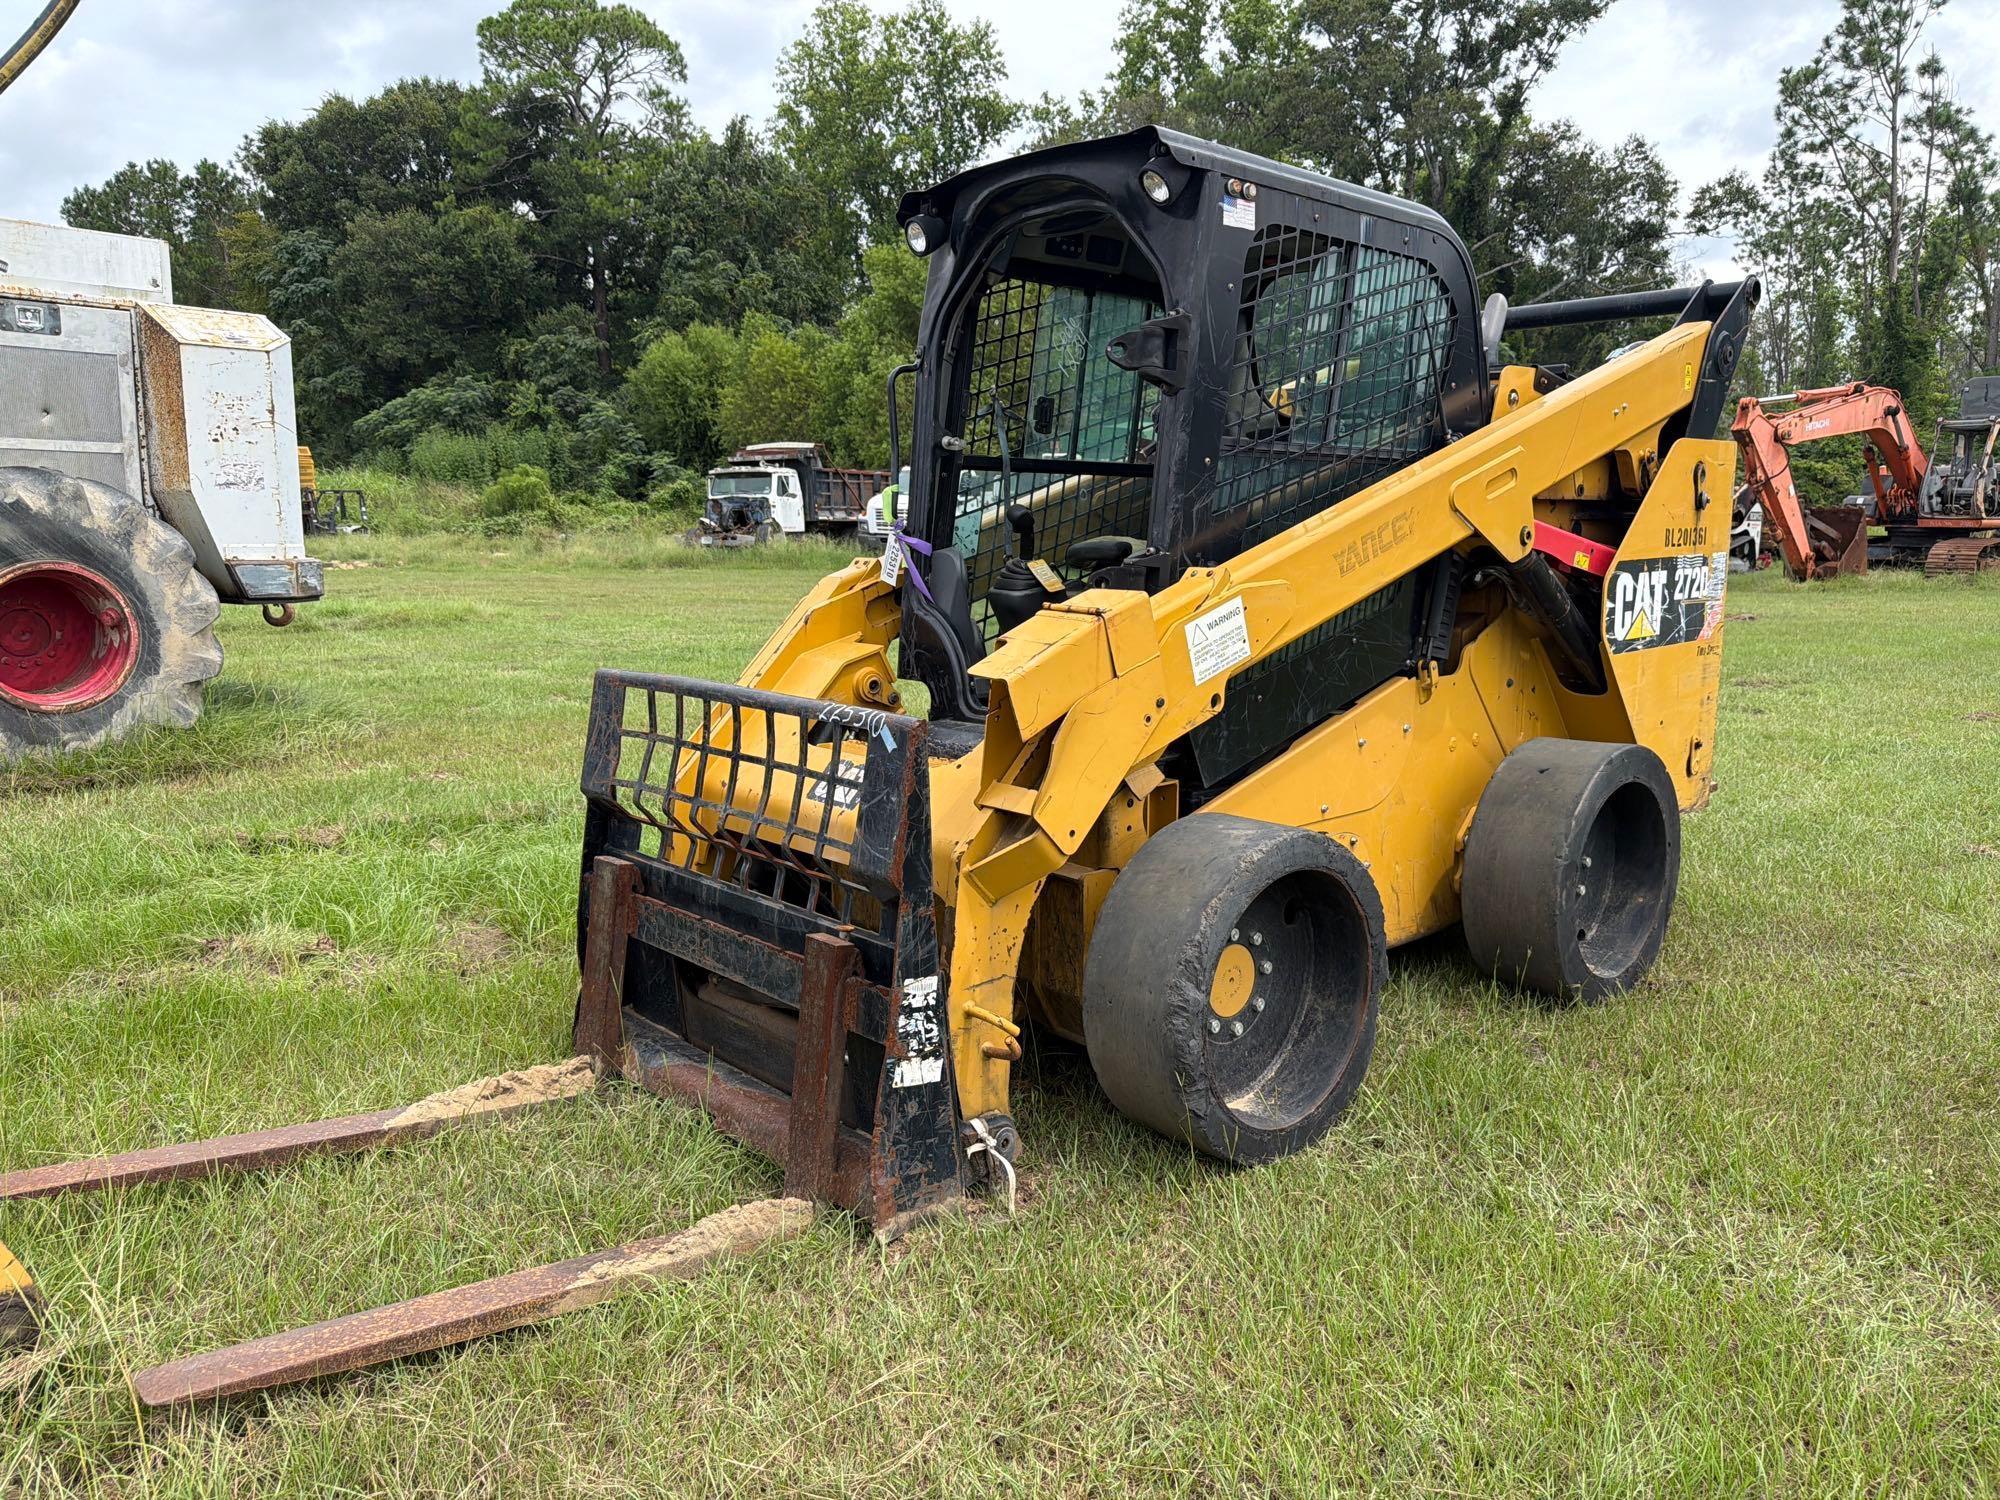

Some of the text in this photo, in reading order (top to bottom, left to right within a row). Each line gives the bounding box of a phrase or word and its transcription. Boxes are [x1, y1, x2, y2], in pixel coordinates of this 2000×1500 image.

[886, 546, 899, 578] 225310
[1206, 606, 1241, 632] WARNING
[1616, 570, 1667, 641] CAT
